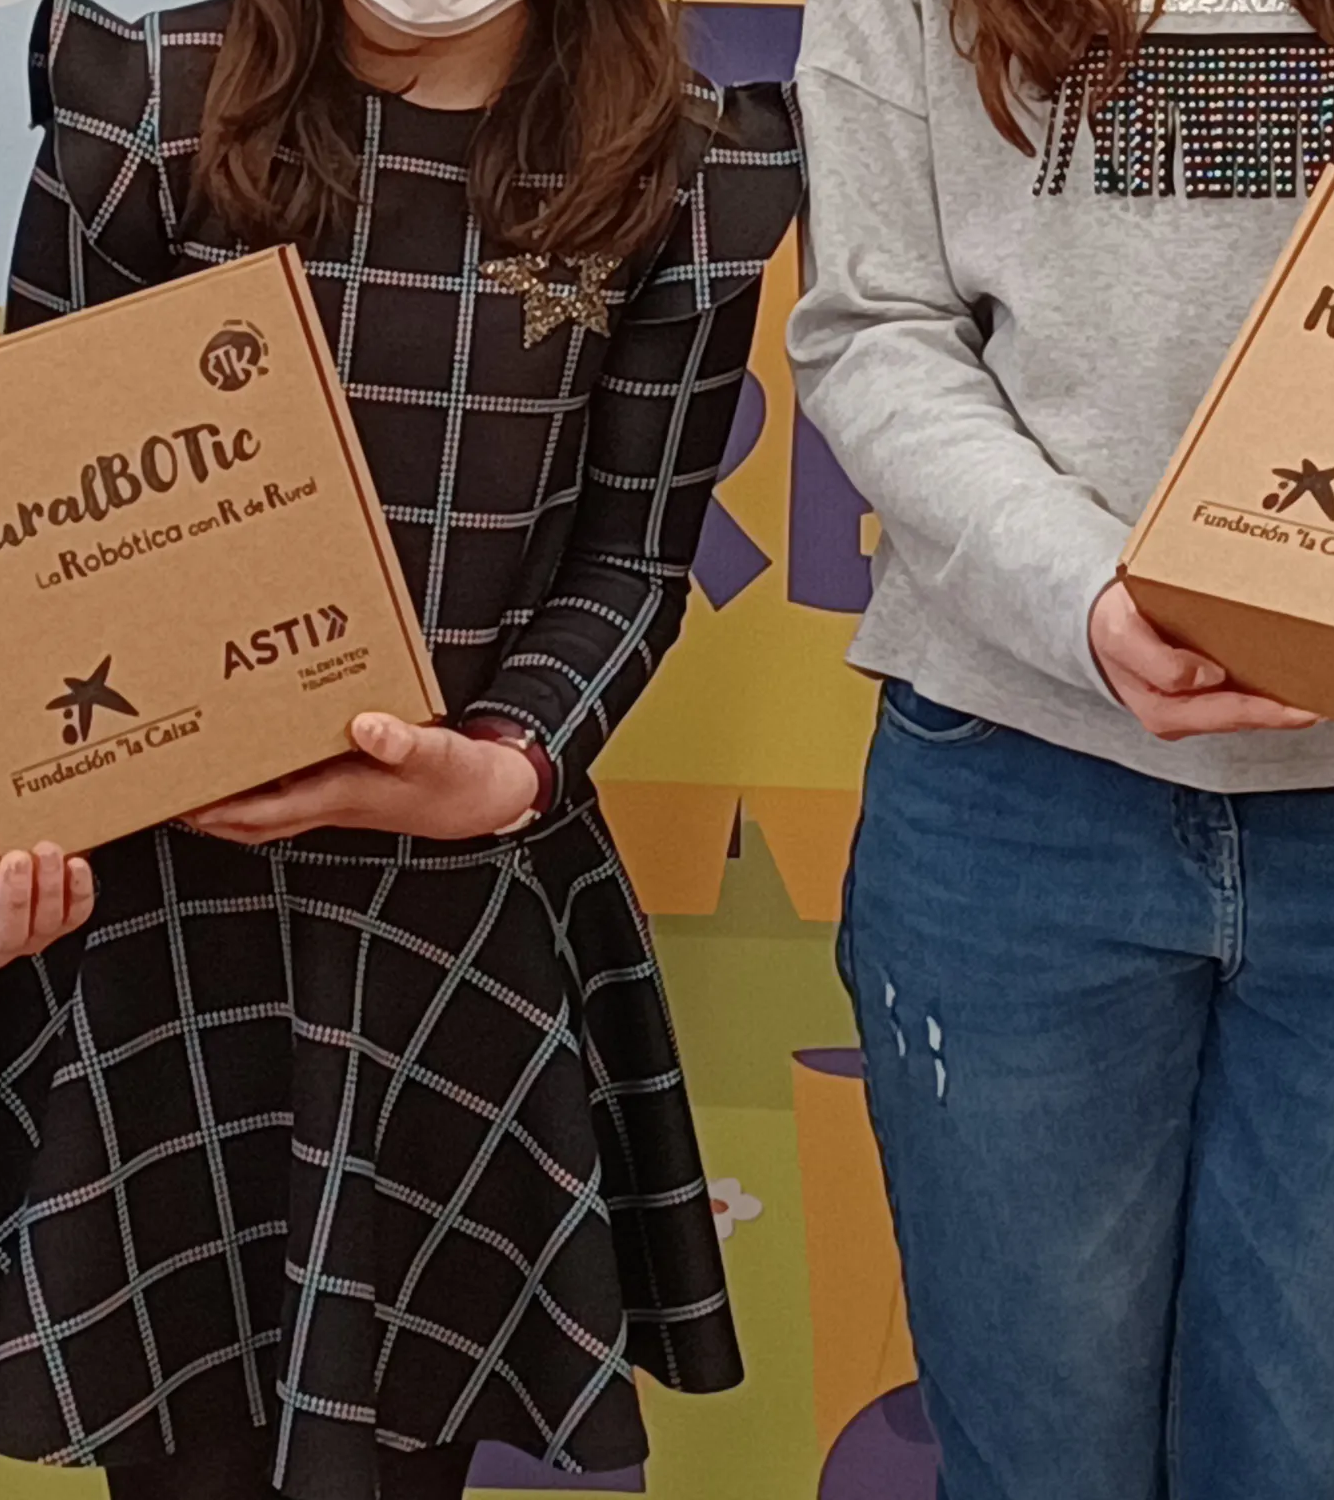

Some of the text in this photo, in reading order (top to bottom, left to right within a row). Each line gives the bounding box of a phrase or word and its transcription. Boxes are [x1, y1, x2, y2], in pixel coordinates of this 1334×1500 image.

[35, 476, 318, 589] La Robótica con R de Rural
[223, 613, 320, 680] ASTI
